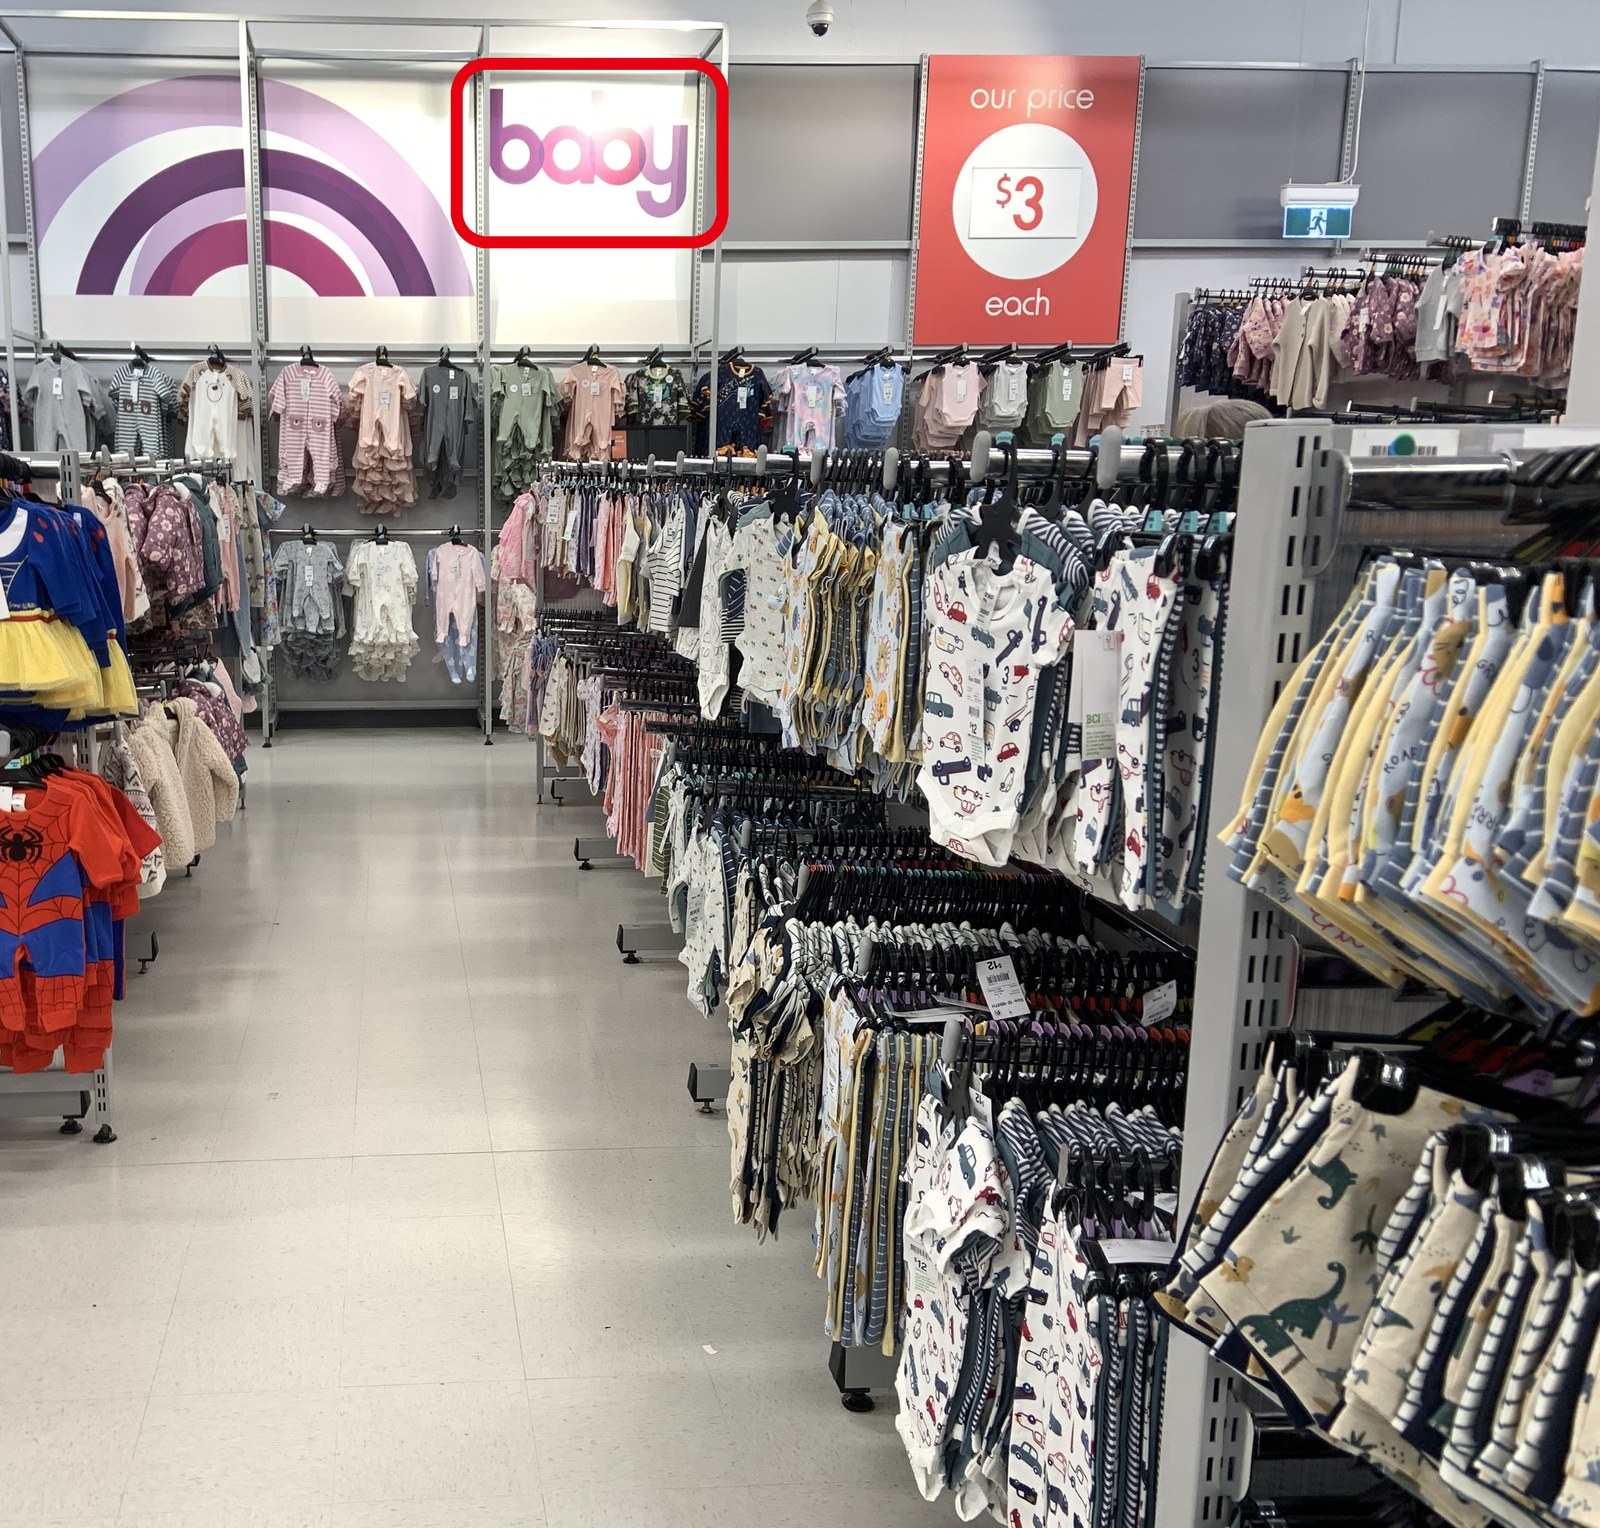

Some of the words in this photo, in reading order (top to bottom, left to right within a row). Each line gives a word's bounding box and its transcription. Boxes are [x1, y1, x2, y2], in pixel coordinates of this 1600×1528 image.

[970, 88, 1017, 110] our
[1026, 83, 1096, 119] price
[489, 88, 689, 219] baby
[995, 172, 1045, 232] $3
[984, 287, 1051, 316] each
[1086, 713, 1101, 724] BCI
[986, 960, 1003, 970] $12
[914, 1256, 928, 1272] $12
